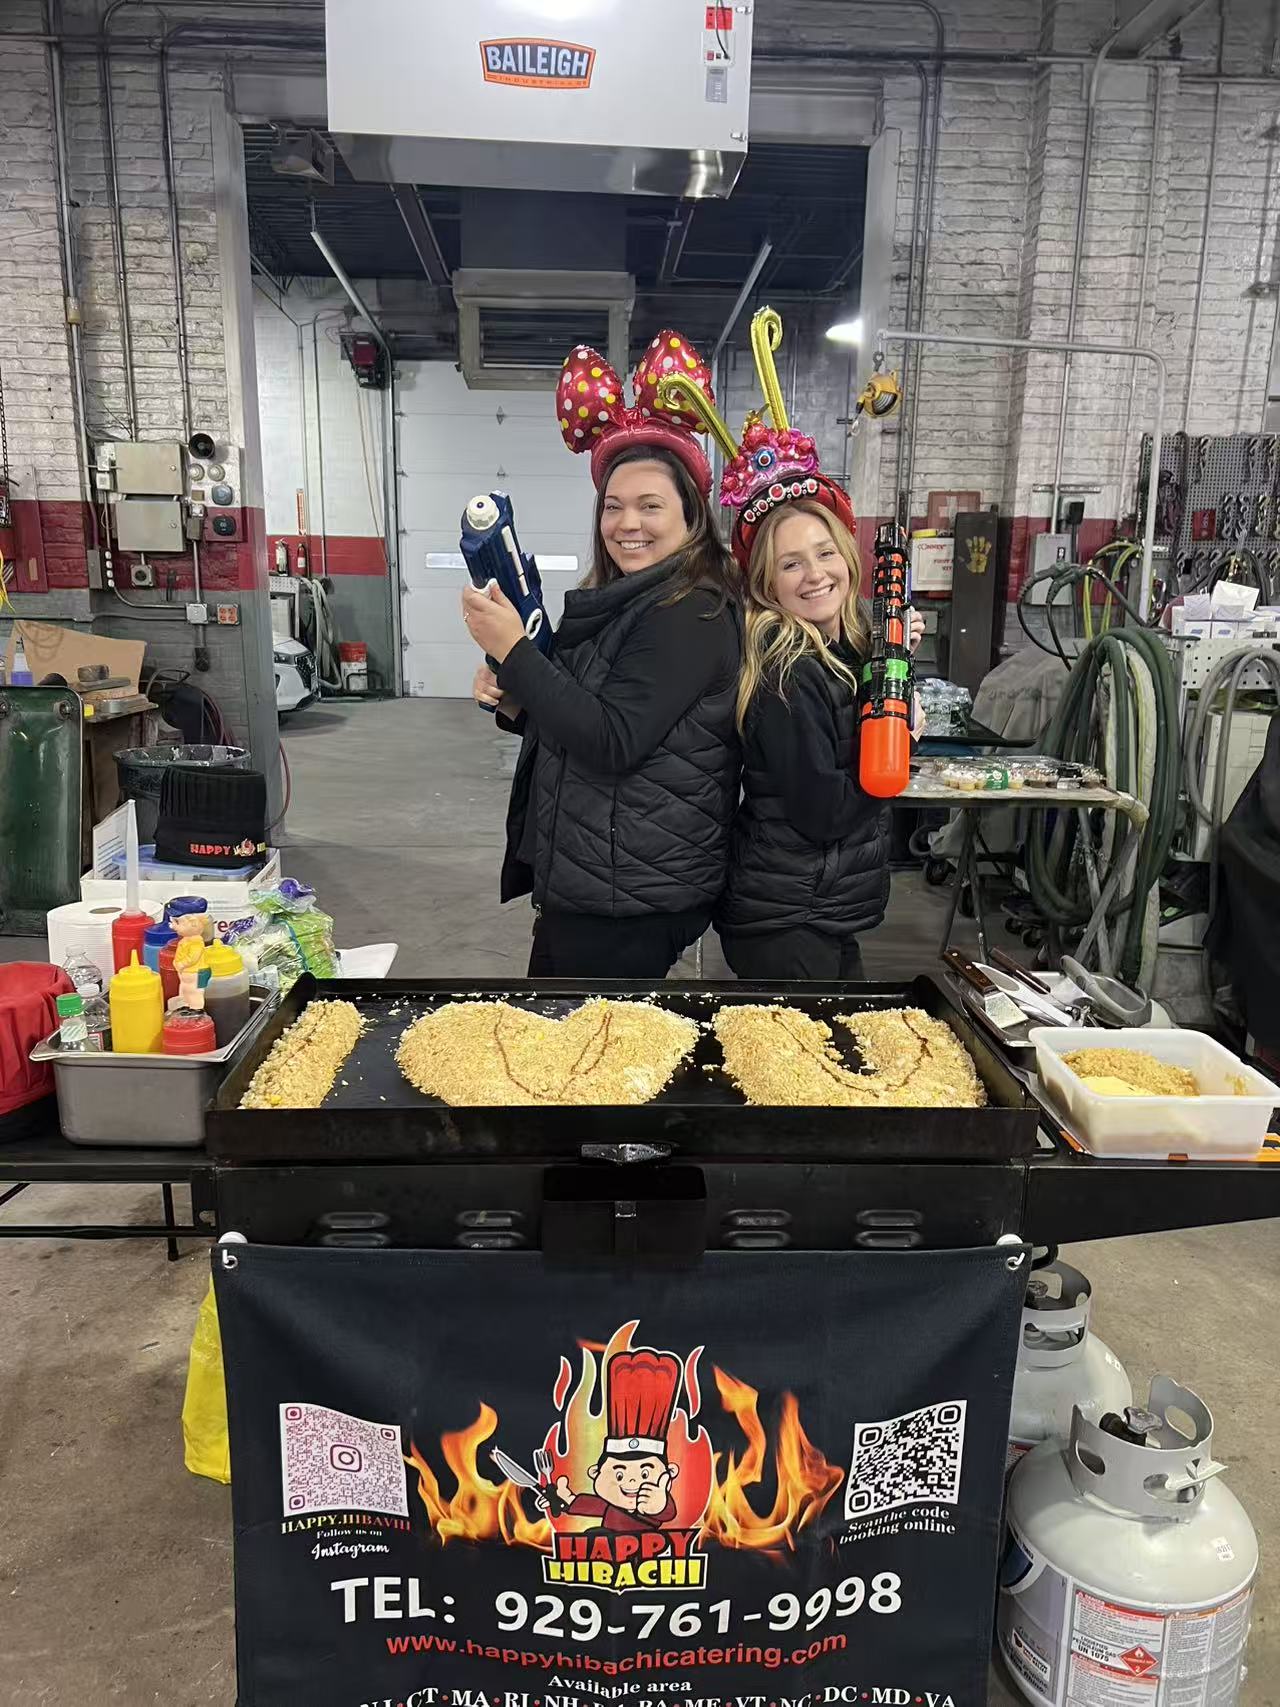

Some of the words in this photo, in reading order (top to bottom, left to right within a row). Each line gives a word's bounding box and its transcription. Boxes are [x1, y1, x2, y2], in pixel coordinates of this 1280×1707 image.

[486, 45, 589, 76] BAILEIGH
[190, 843, 231, 855] HAPPY
[912, 1506, 950, 1519] code
[317, 1529, 351, 1539] Follow
[840, 1522, 900, 1545] booking
[904, 1518, 956, 1534] online
[312, 1542, 389, 1560] Instagram
[559, 1531, 694, 1562] HAPPY
[549, 1559, 701, 1587] HIBACHI
[330, 1576, 456, 1624] TEL:
[495, 1571, 902, 1642] 929-761-9998
[386, 1633, 848, 1675] www.happyhibachicatering.com
[1078, 1644, 1089, 1654] UN
[1090, 1650, 1109, 1662] 1075
[406, 1687, 439, 1707] CT
[451, 1689, 490, 1707] MA
[504, 1692, 540, 1707] RI
[544, 1695, 579, 1707] NH
[823, 1686, 858, 1703] DC
[871, 1687, 911, 1705] MD
[924, 1692, 956, 1707] VA
[548, 1675, 641, 1699] Available
[647, 1681, 692, 1692] area
